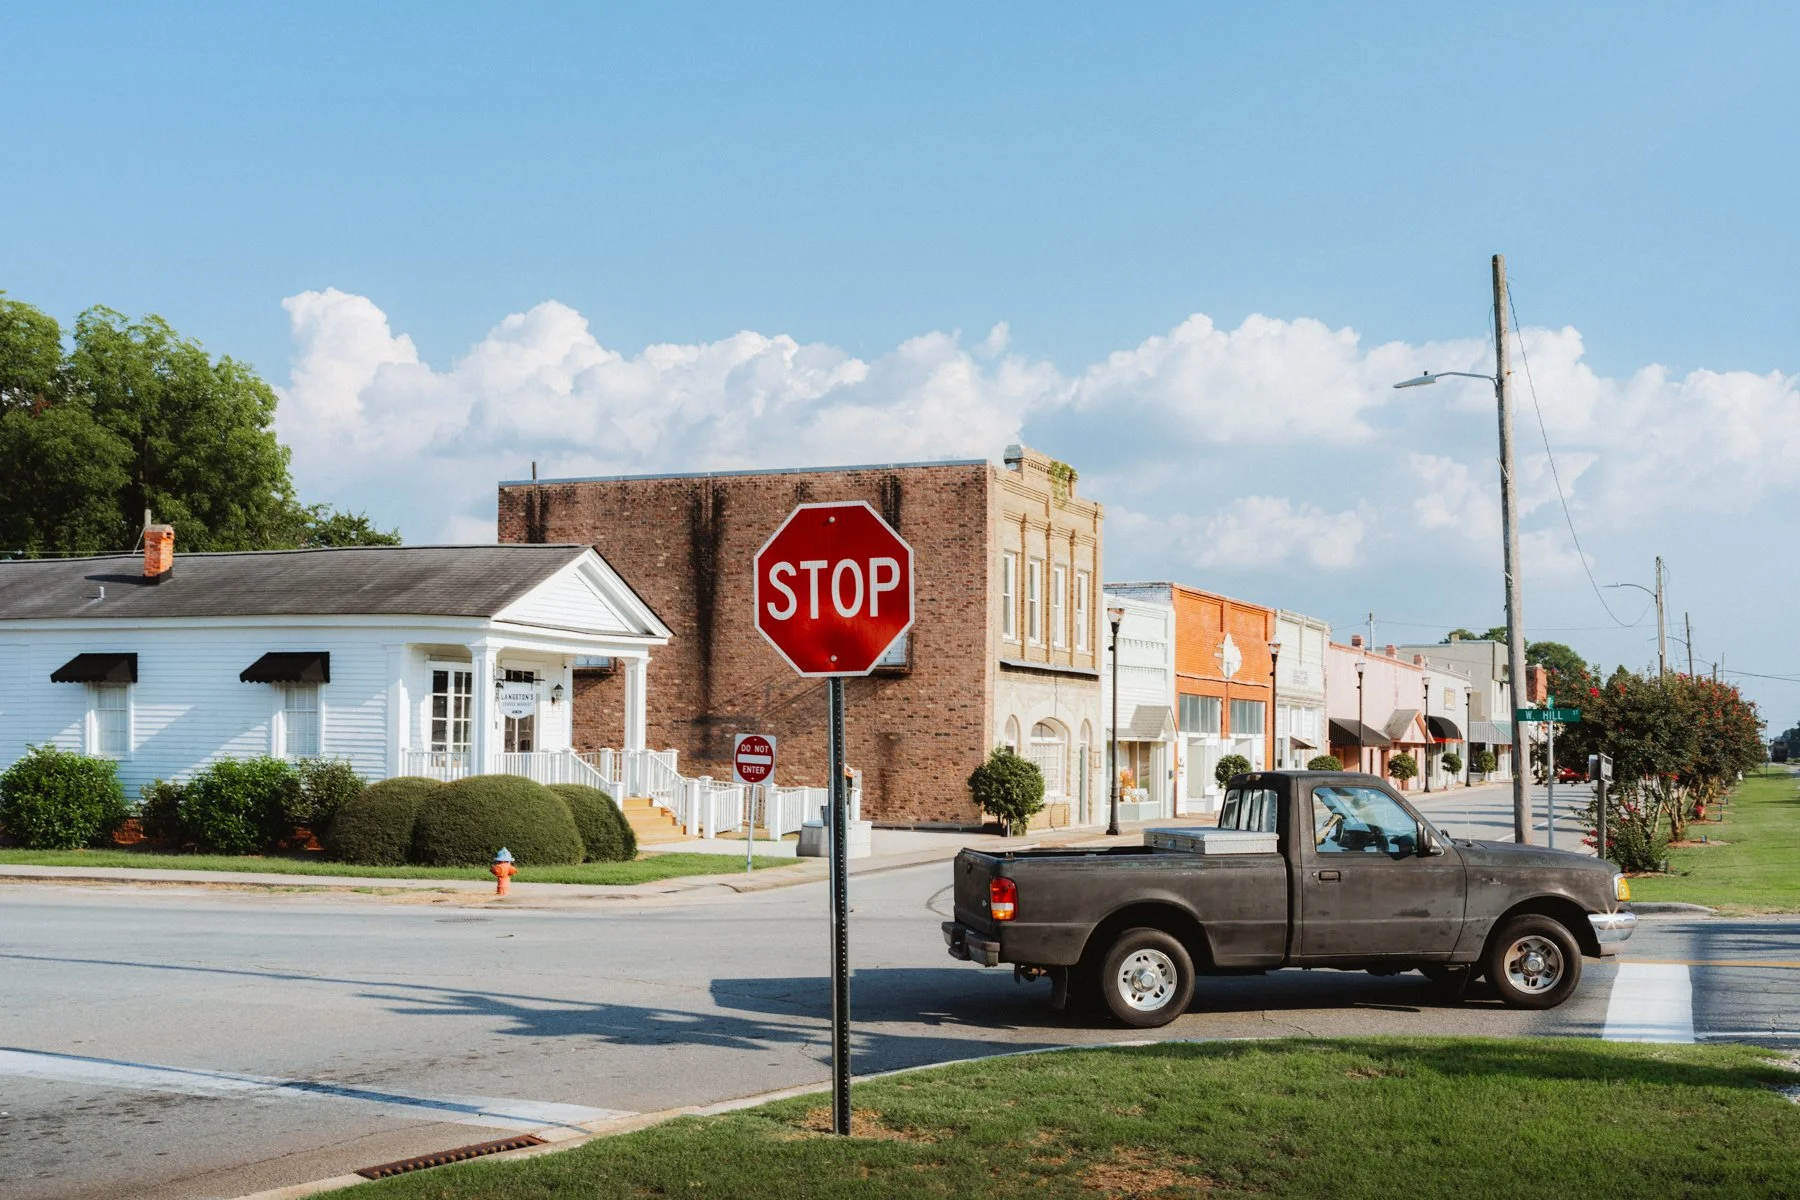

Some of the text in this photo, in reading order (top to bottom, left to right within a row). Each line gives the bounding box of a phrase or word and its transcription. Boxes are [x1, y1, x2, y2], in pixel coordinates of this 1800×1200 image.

[767, 557, 900, 621] STOP
[1525, 711, 1535, 720] W.
[1542, 711, 1563, 720] HILL
[741, 744, 769, 753] DO NOT
[742, 765, 765, 774] ENTER
